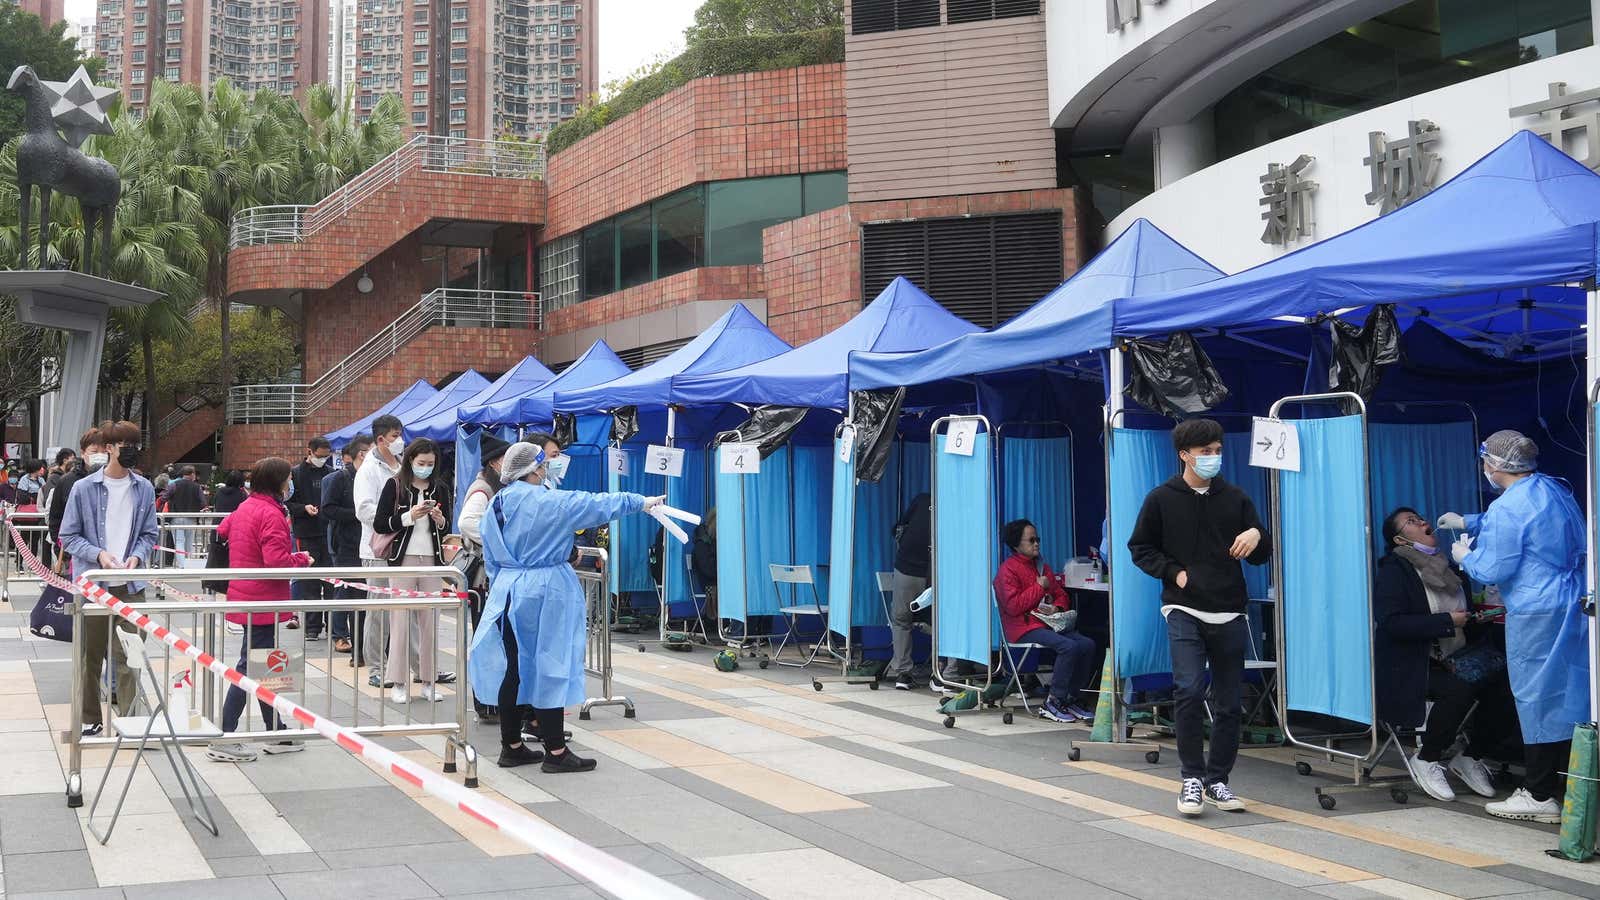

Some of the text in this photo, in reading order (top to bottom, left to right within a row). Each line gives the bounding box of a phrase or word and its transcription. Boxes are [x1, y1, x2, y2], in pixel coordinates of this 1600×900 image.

[955, 431, 964, 448] 6
[1276, 431, 1287, 460] 8
[617, 459, 623, 471] 2
[658, 457, 668, 471] 3
[734, 455, 745, 468] 4
